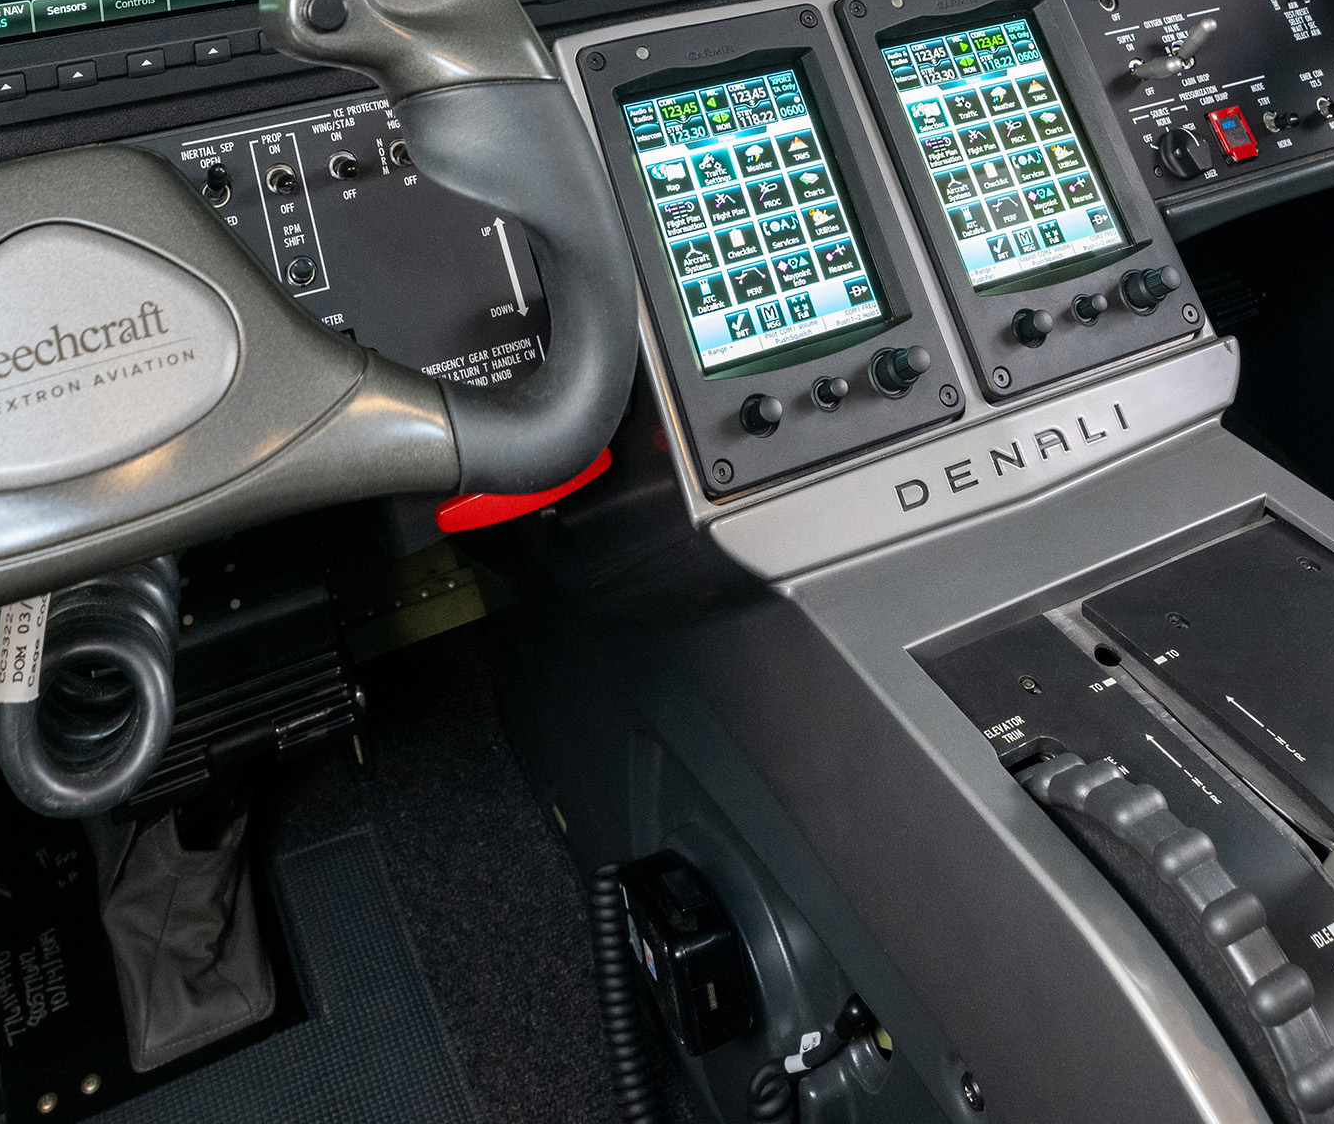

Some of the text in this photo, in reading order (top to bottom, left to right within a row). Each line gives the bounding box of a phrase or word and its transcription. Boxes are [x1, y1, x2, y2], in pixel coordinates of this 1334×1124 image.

[47, 1, 87, 16] Sensors
[333, 99, 389, 119] ICE PROTECTION
[662, 102, 698, 120] 123.45
[1150, 107, 1170, 118] SOURCE
[312, 117, 355, 134] WING/STAB
[261, 132, 282, 144] PROP
[181, 142, 235, 161] INERTIAL SEP
[283, 224, 302, 236] RPM
[283, 234, 305, 248] SHIFT
[727, 244, 757, 259] Checklist
[490, 303, 514, 318] DOWN
[468, 338, 531, 364] GEAR EXTENSION
[93, 349, 196, 387] AVIATION
[894, 403, 1129, 513] DENALI
[984, 714, 1026, 740] ELEVATOR
[1002, 728, 1025, 745] TRIM
[1310, 927, 1333, 948] IDLE
